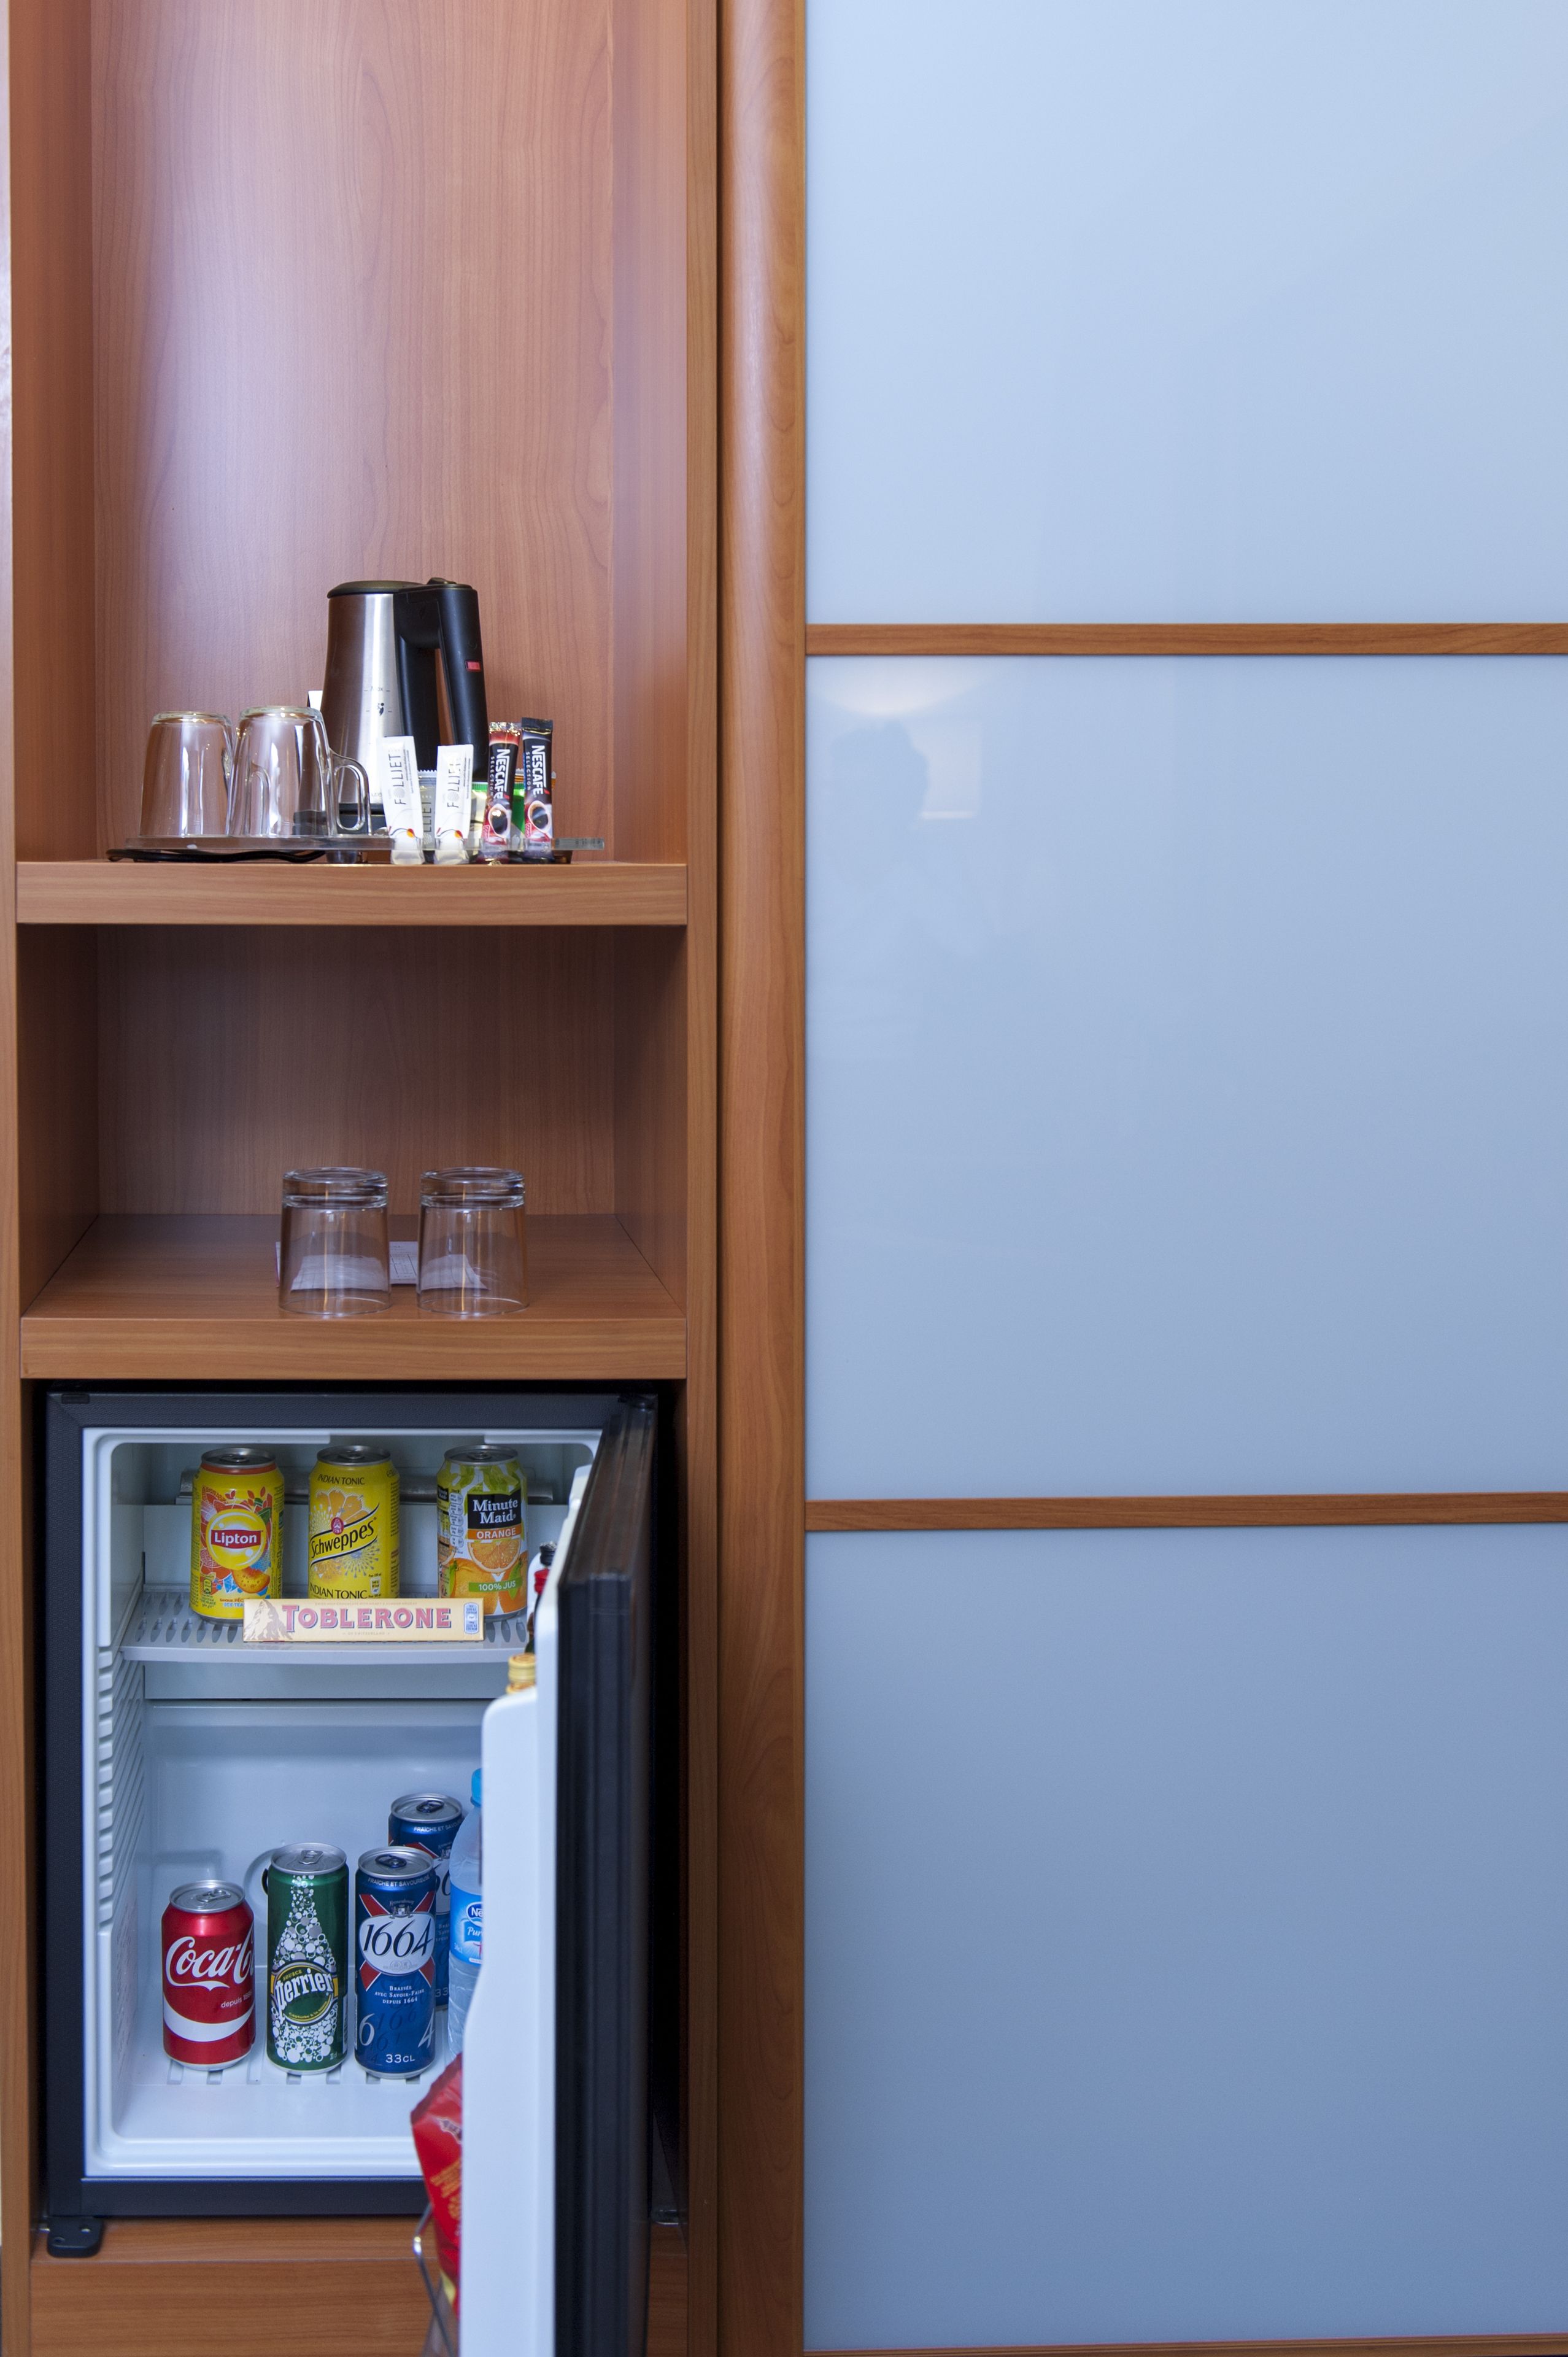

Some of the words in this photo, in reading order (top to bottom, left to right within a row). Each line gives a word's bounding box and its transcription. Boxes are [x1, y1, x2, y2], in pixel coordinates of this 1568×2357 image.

[531, 745, 550, 795] NESCAFÉ
[317, 1474, 339, 1484] INDIAN
[341, 1477, 365, 1485] TONIC
[473, 1498, 518, 1512] Minute
[480, 1509, 514, 1524] Maid
[214, 1532, 257, 1546] Lipton
[311, 1520, 374, 1558] Schweppes
[477, 1528, 516, 1539] ORANGE
[335, 1590, 368, 1599] TONIC
[282, 1604, 452, 1633] TOBLERONE
[363, 1918, 433, 1957] 1664
[221, 1996, 242, 2008] depuis
